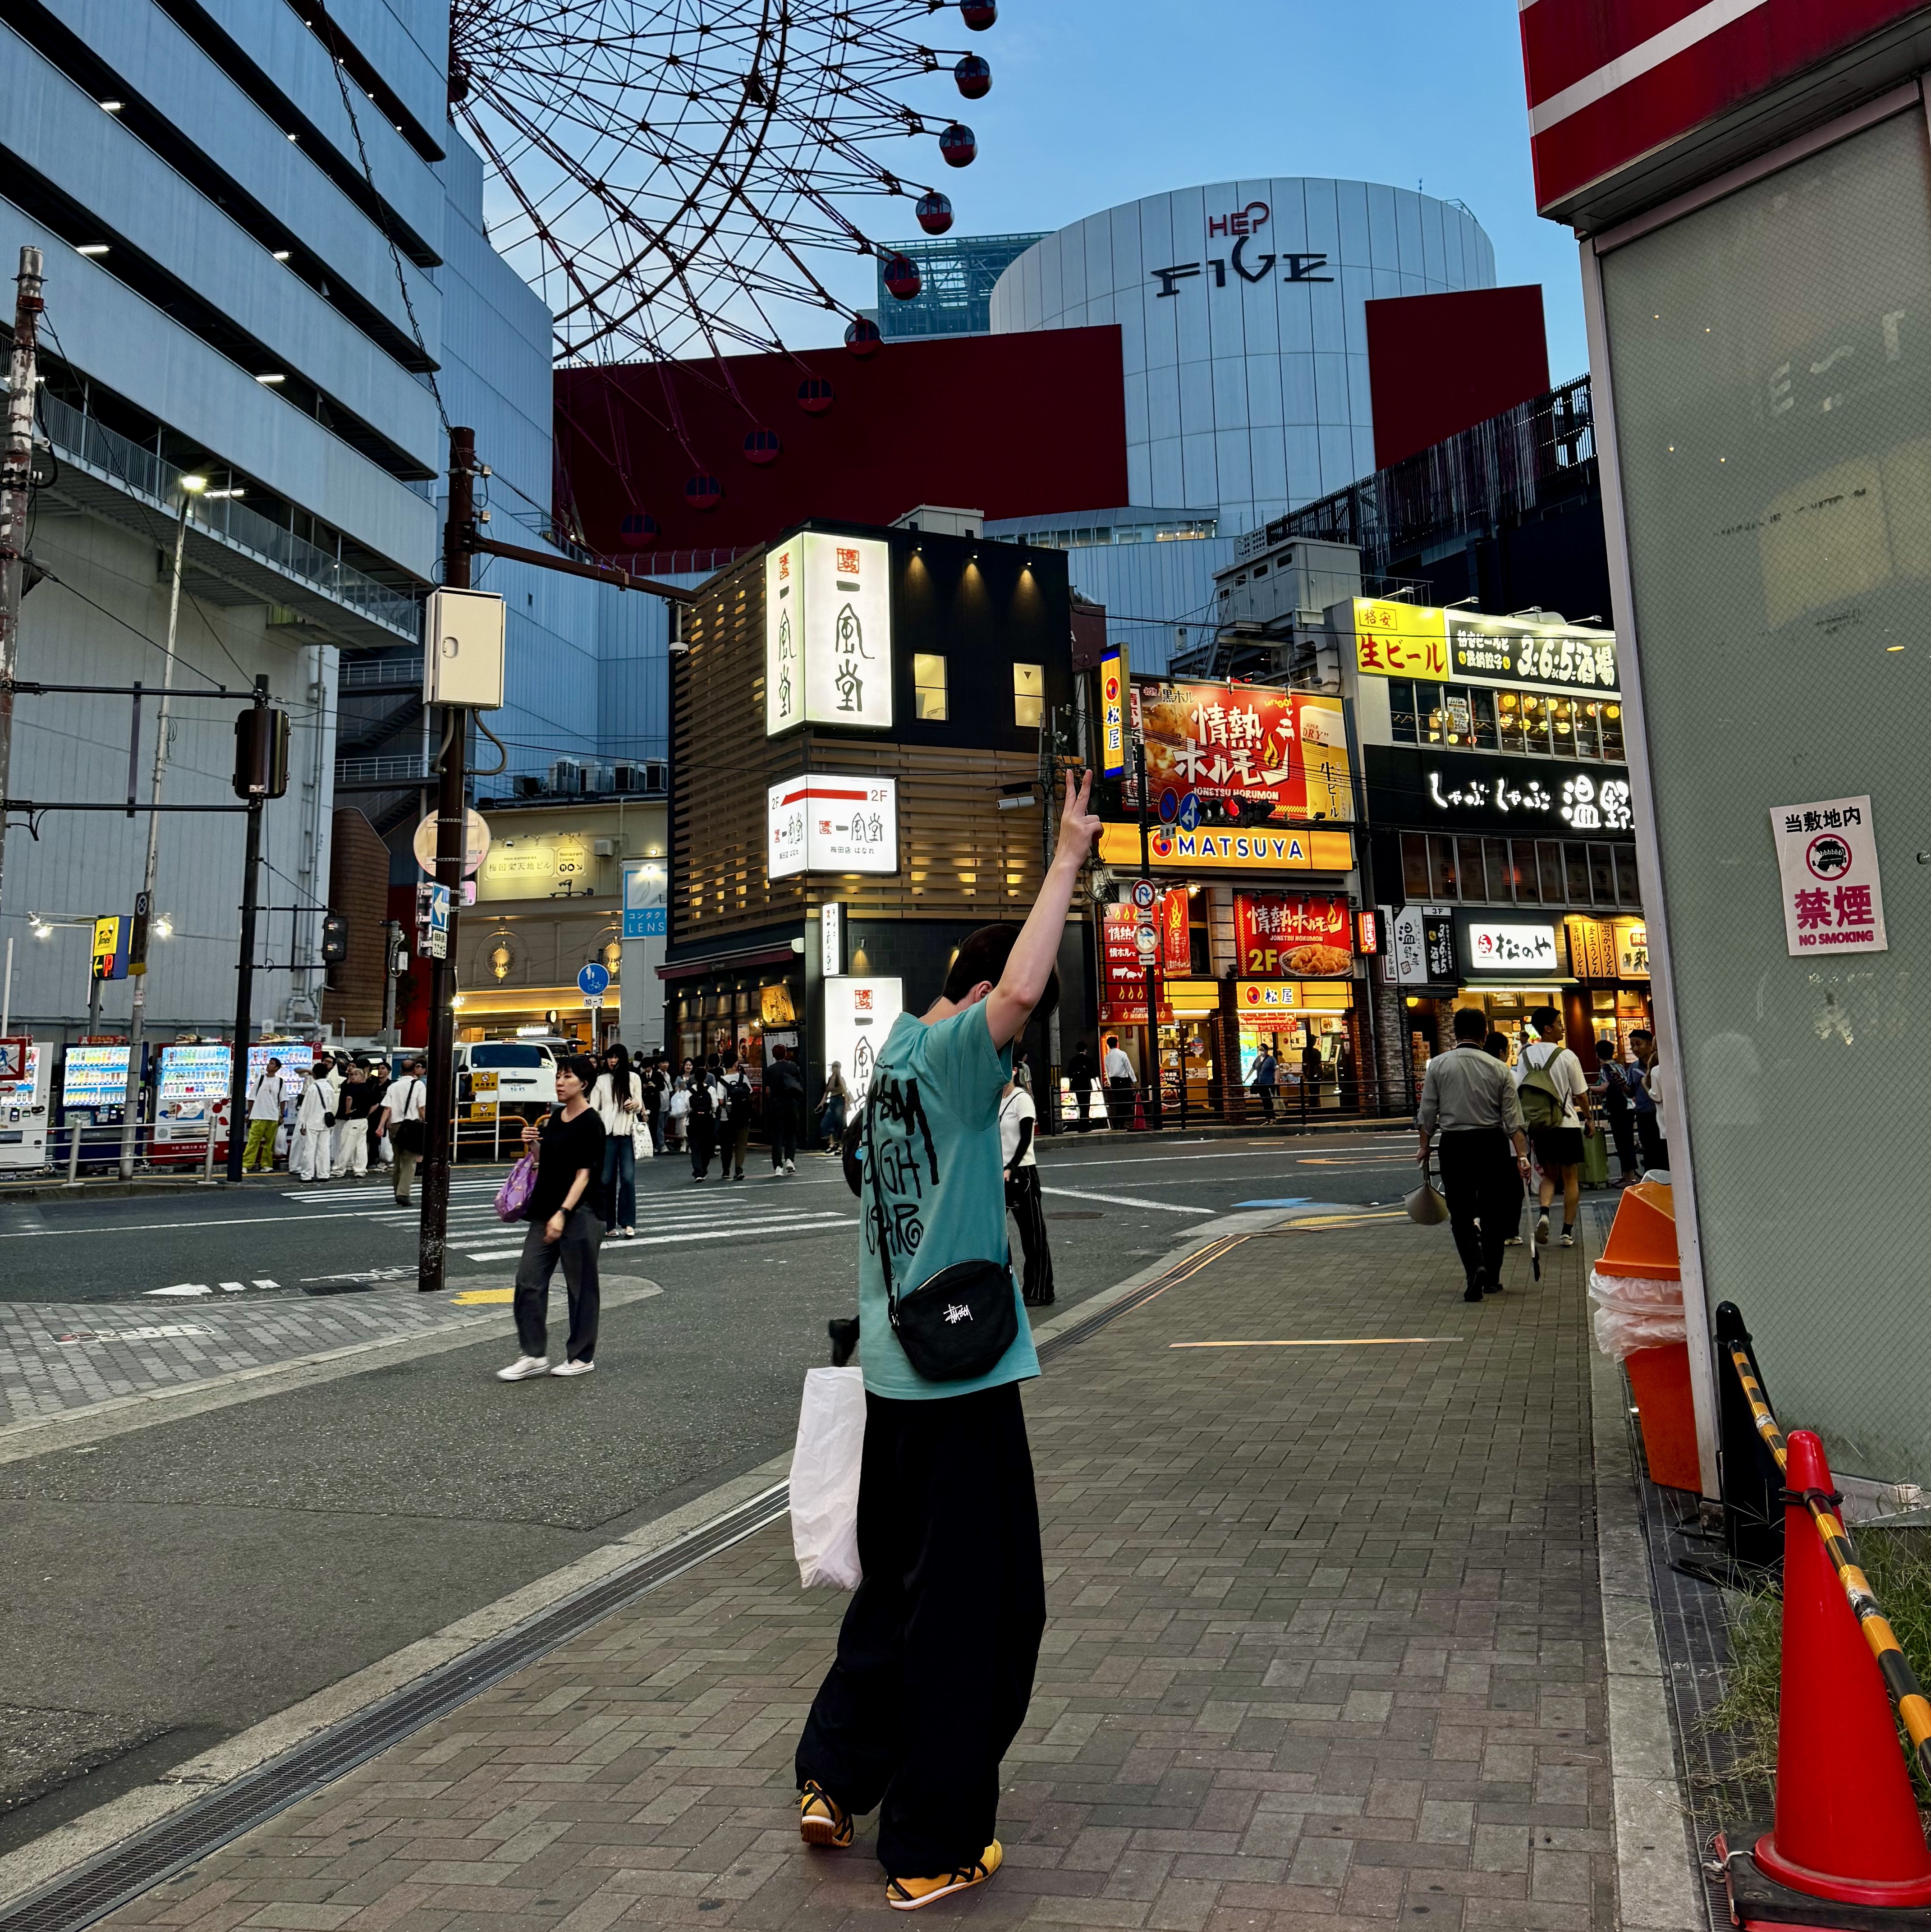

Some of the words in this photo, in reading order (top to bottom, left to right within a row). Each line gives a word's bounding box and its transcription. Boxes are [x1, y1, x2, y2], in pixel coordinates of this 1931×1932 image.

[1209, 202, 1270, 238] HEP
[1151, 236, 1334, 297] FIVE
[1365, 609, 1391, 627] 格安
[779, 586, 797, 718] 一風堂
[835, 580, 875, 712] 一風堂
[1360, 632, 1445, 673] 生ビール
[1162, 689, 1197, 703] 黒ホル
[1107, 706, 1119, 749] 松屋
[1191, 702, 1264, 749] 情熱
[1173, 737, 1289, 786] ホルモン
[772, 796, 780, 810] 2F
[871, 790, 888, 801] 2F
[1192, 787, 1231, 797] JONETSU
[1234, 789, 1280, 801] HORUMON
[1561, 774, 1636, 830] 温野
[836, 812, 883, 843] 一風堂
[1785, 806, 1862, 833] 当敷地内
[1178, 835, 1304, 859] MATSUYA
[489, 862, 551, 872] 梅田楽天地ビル
[1246, 904, 1342, 935] 情熱ホルモン
[1794, 885, 1875, 929] 禁煙
[628, 922, 665, 933] LENS
[1799, 935, 1816, 946] NO
[1819, 930, 1874, 945] SMOKING
[1249, 949, 1277, 971] 2F
[1495, 933, 1551, 960] 松のや
[1602, 925, 1614, 976] ぶっかけうどん
[103, 955, 113, 977] P
[1265, 988, 1292, 1003] 松屋
